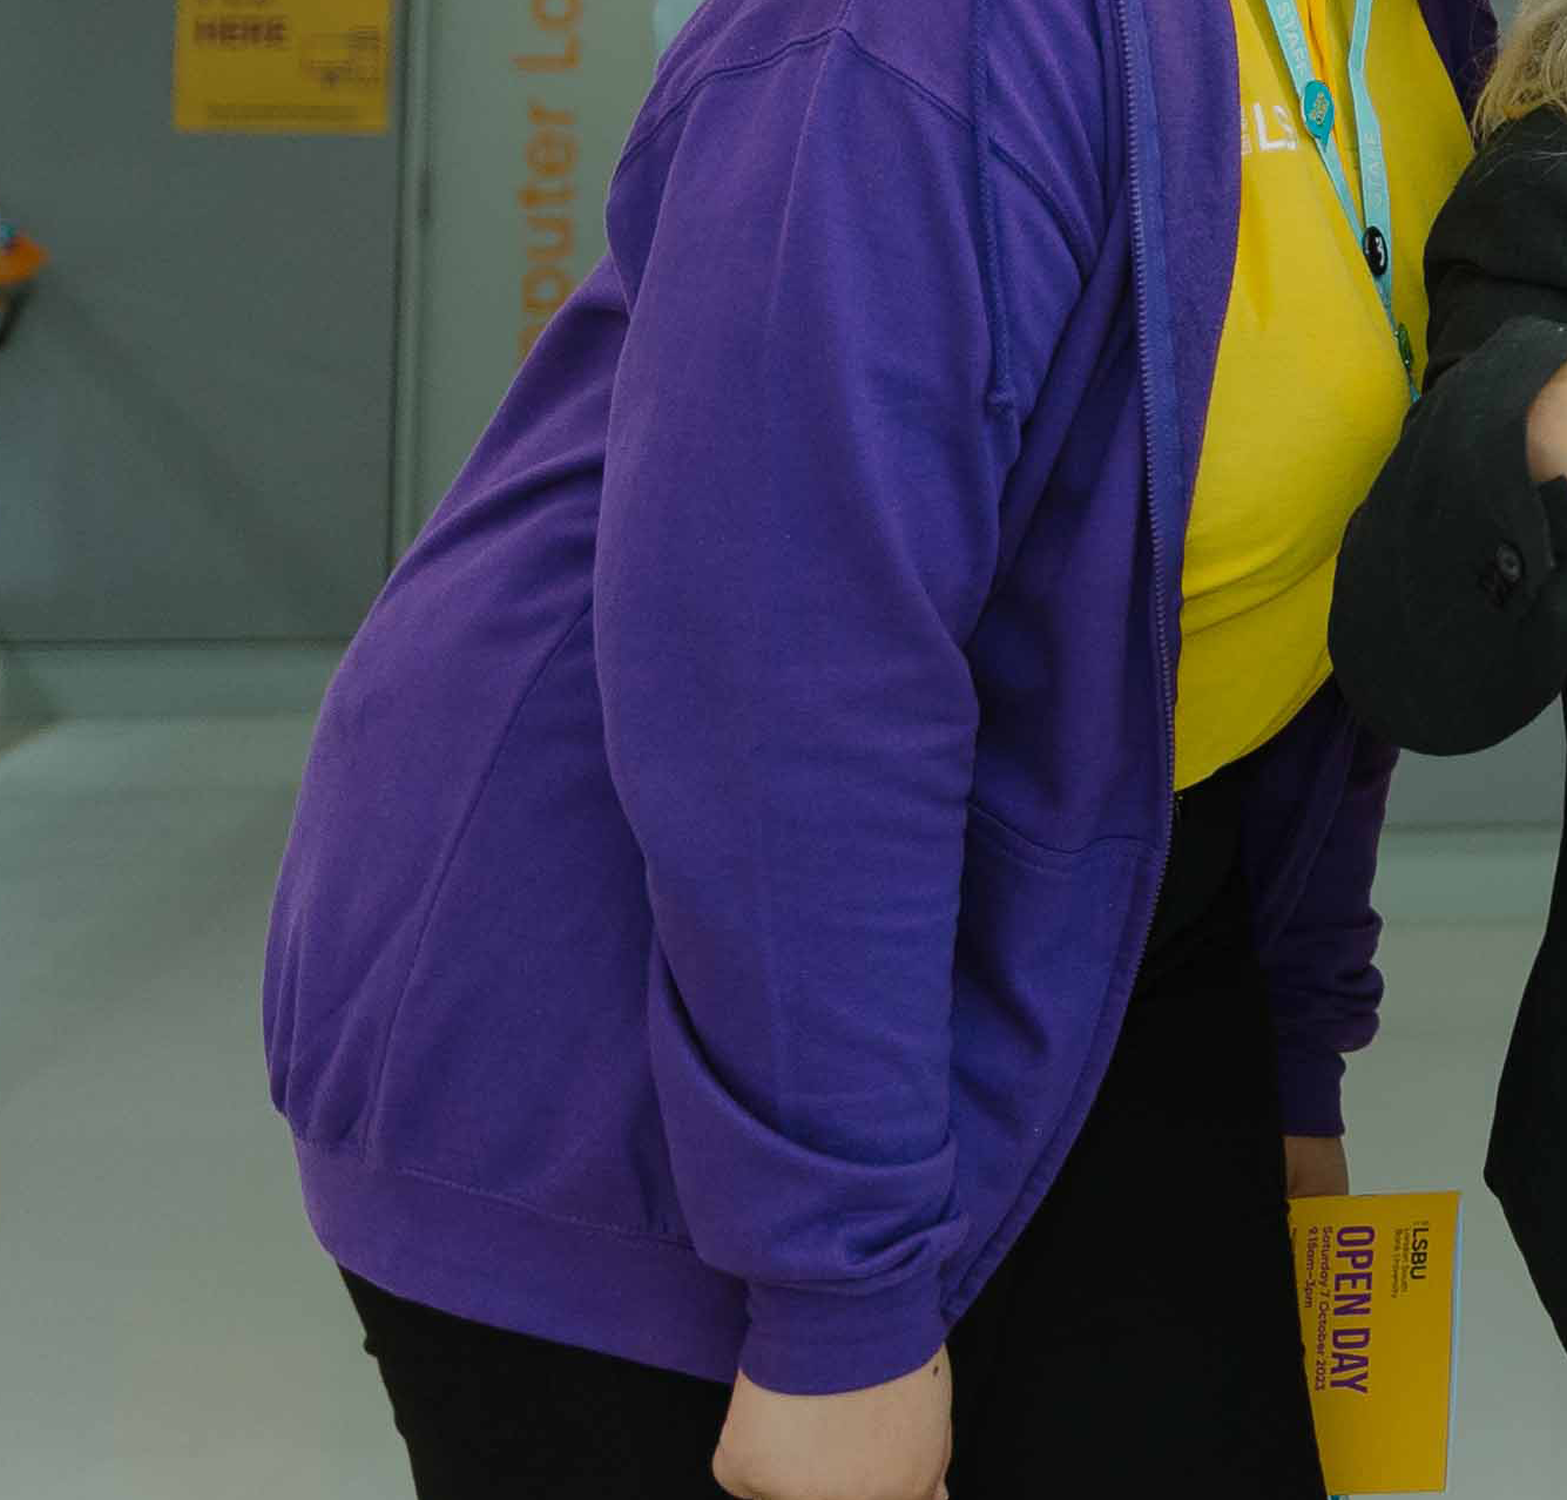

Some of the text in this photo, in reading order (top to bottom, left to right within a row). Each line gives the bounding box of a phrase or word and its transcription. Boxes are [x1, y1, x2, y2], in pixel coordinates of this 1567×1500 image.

[194, 15, 287, 45] HERE
[516, 100, 583, 358] puter
[1319, 1226, 1334, 1287] Saturday
[1409, 1227, 1429, 1280] LSBU
[1317, 1301, 1330, 1355] October
[1329, 1225, 1375, 1394] OPEN DAY
